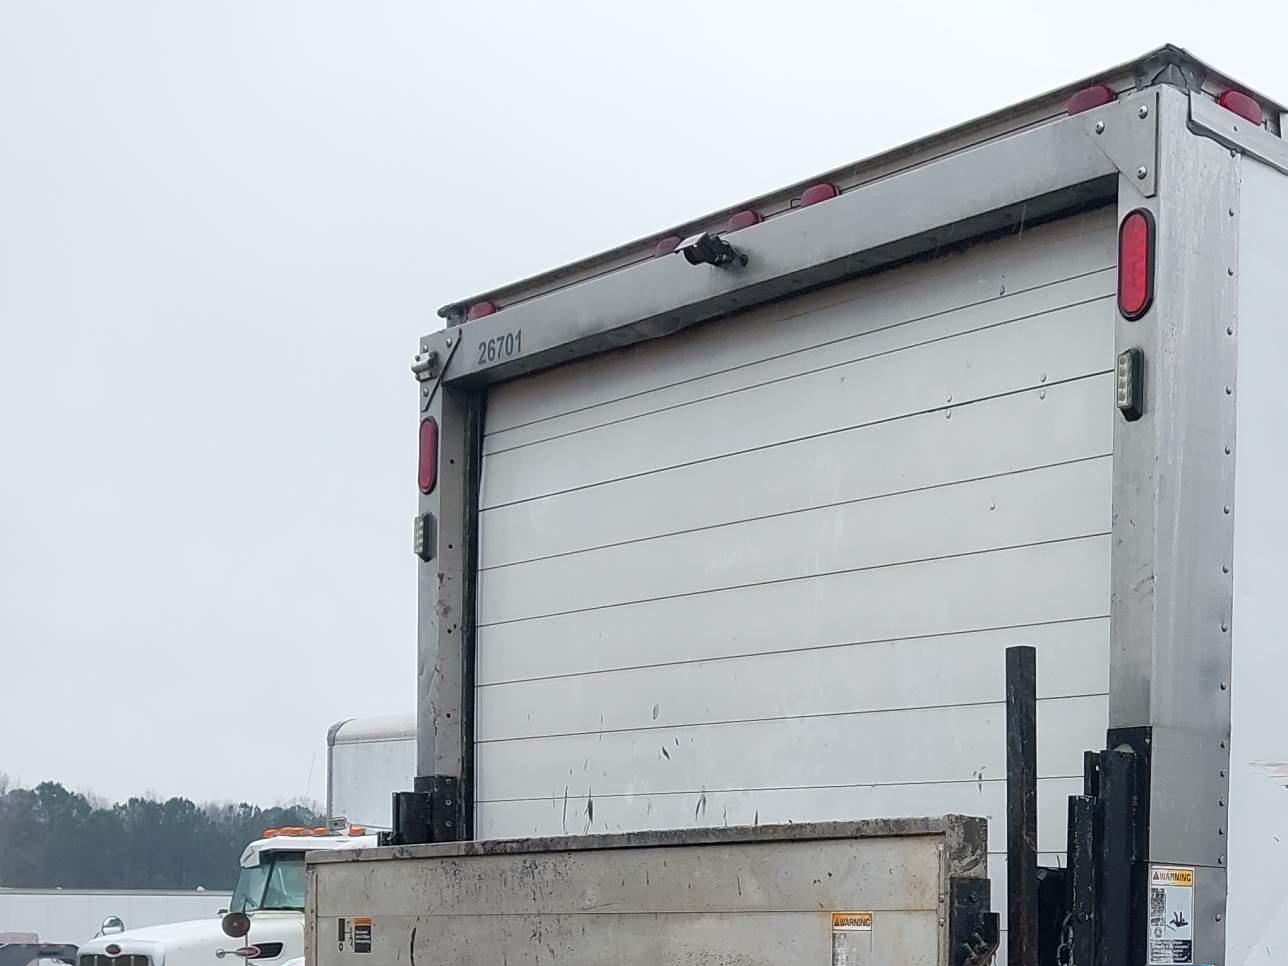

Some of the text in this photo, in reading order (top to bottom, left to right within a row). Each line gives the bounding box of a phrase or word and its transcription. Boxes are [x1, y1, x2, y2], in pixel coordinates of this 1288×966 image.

[478, 328, 523, 365] 26701
[1159, 871, 1192, 882] WARNING
[839, 917, 871, 927] WARNING
